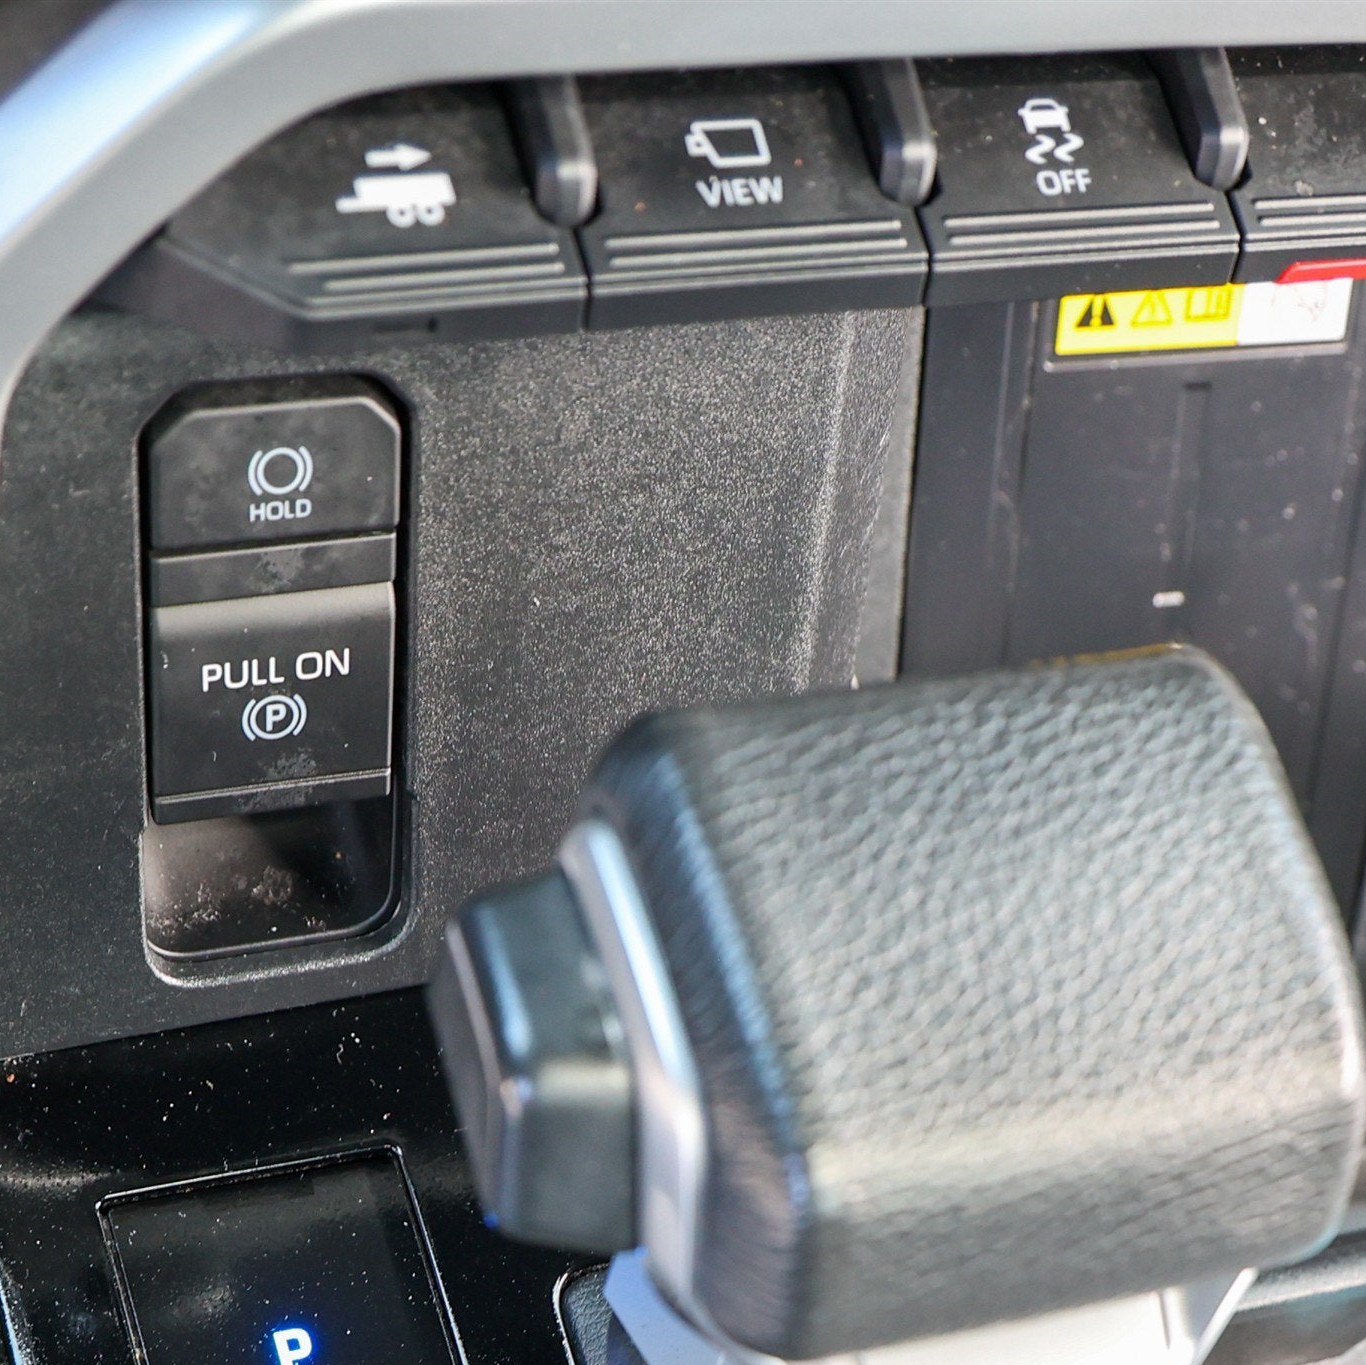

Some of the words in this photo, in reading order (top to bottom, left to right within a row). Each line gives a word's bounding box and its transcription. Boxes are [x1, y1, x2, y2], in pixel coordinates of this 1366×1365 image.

[696, 176, 783, 208] VIEW
[1036, 169, 1092, 196] OFF
[249, 499, 312, 522] HOLD
[201, 657, 285, 692] PULL
[295, 648, 350, 680] ON
